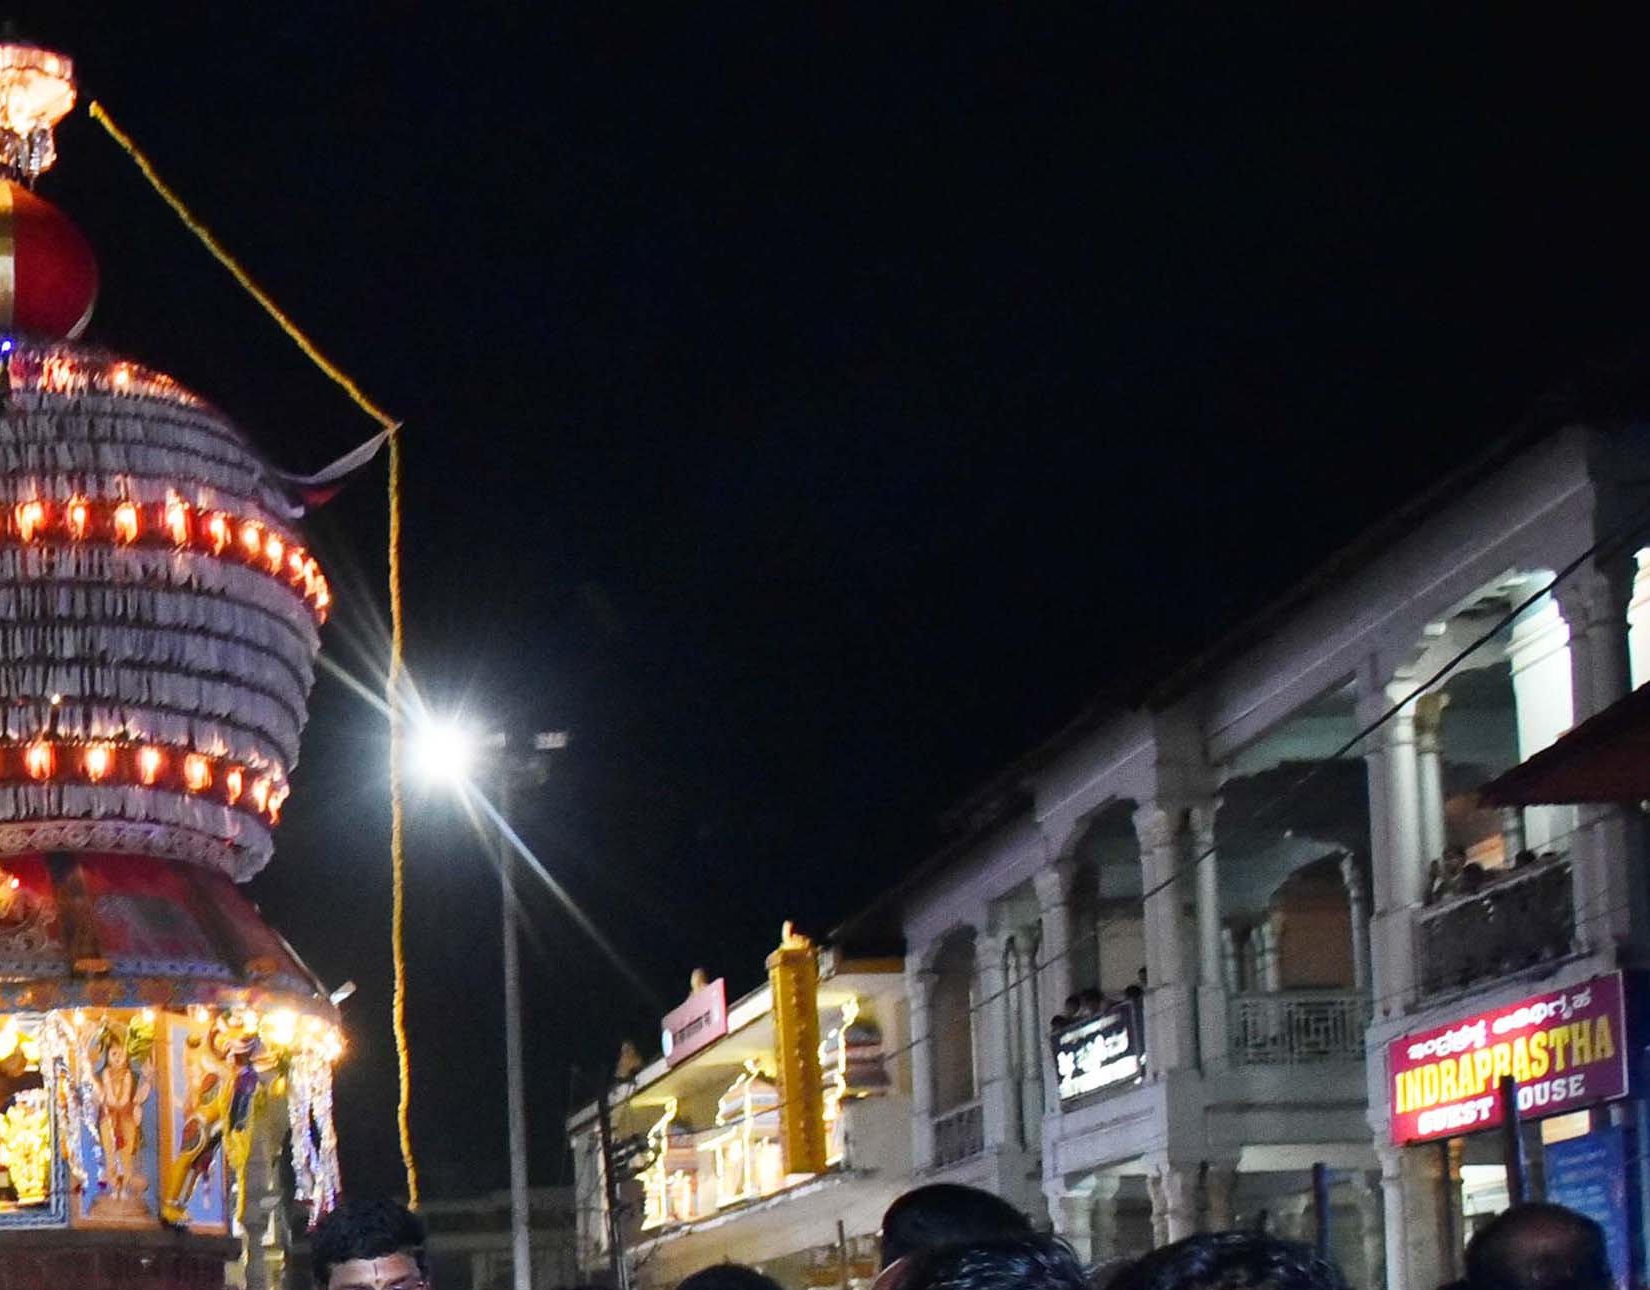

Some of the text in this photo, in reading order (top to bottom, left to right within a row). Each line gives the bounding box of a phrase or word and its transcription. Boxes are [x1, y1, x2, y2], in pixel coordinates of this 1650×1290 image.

[1395, 1014, 1615, 1114] INDRAPRASTHA
[1417, 1074, 1586, 1135] GUEST OUSE
